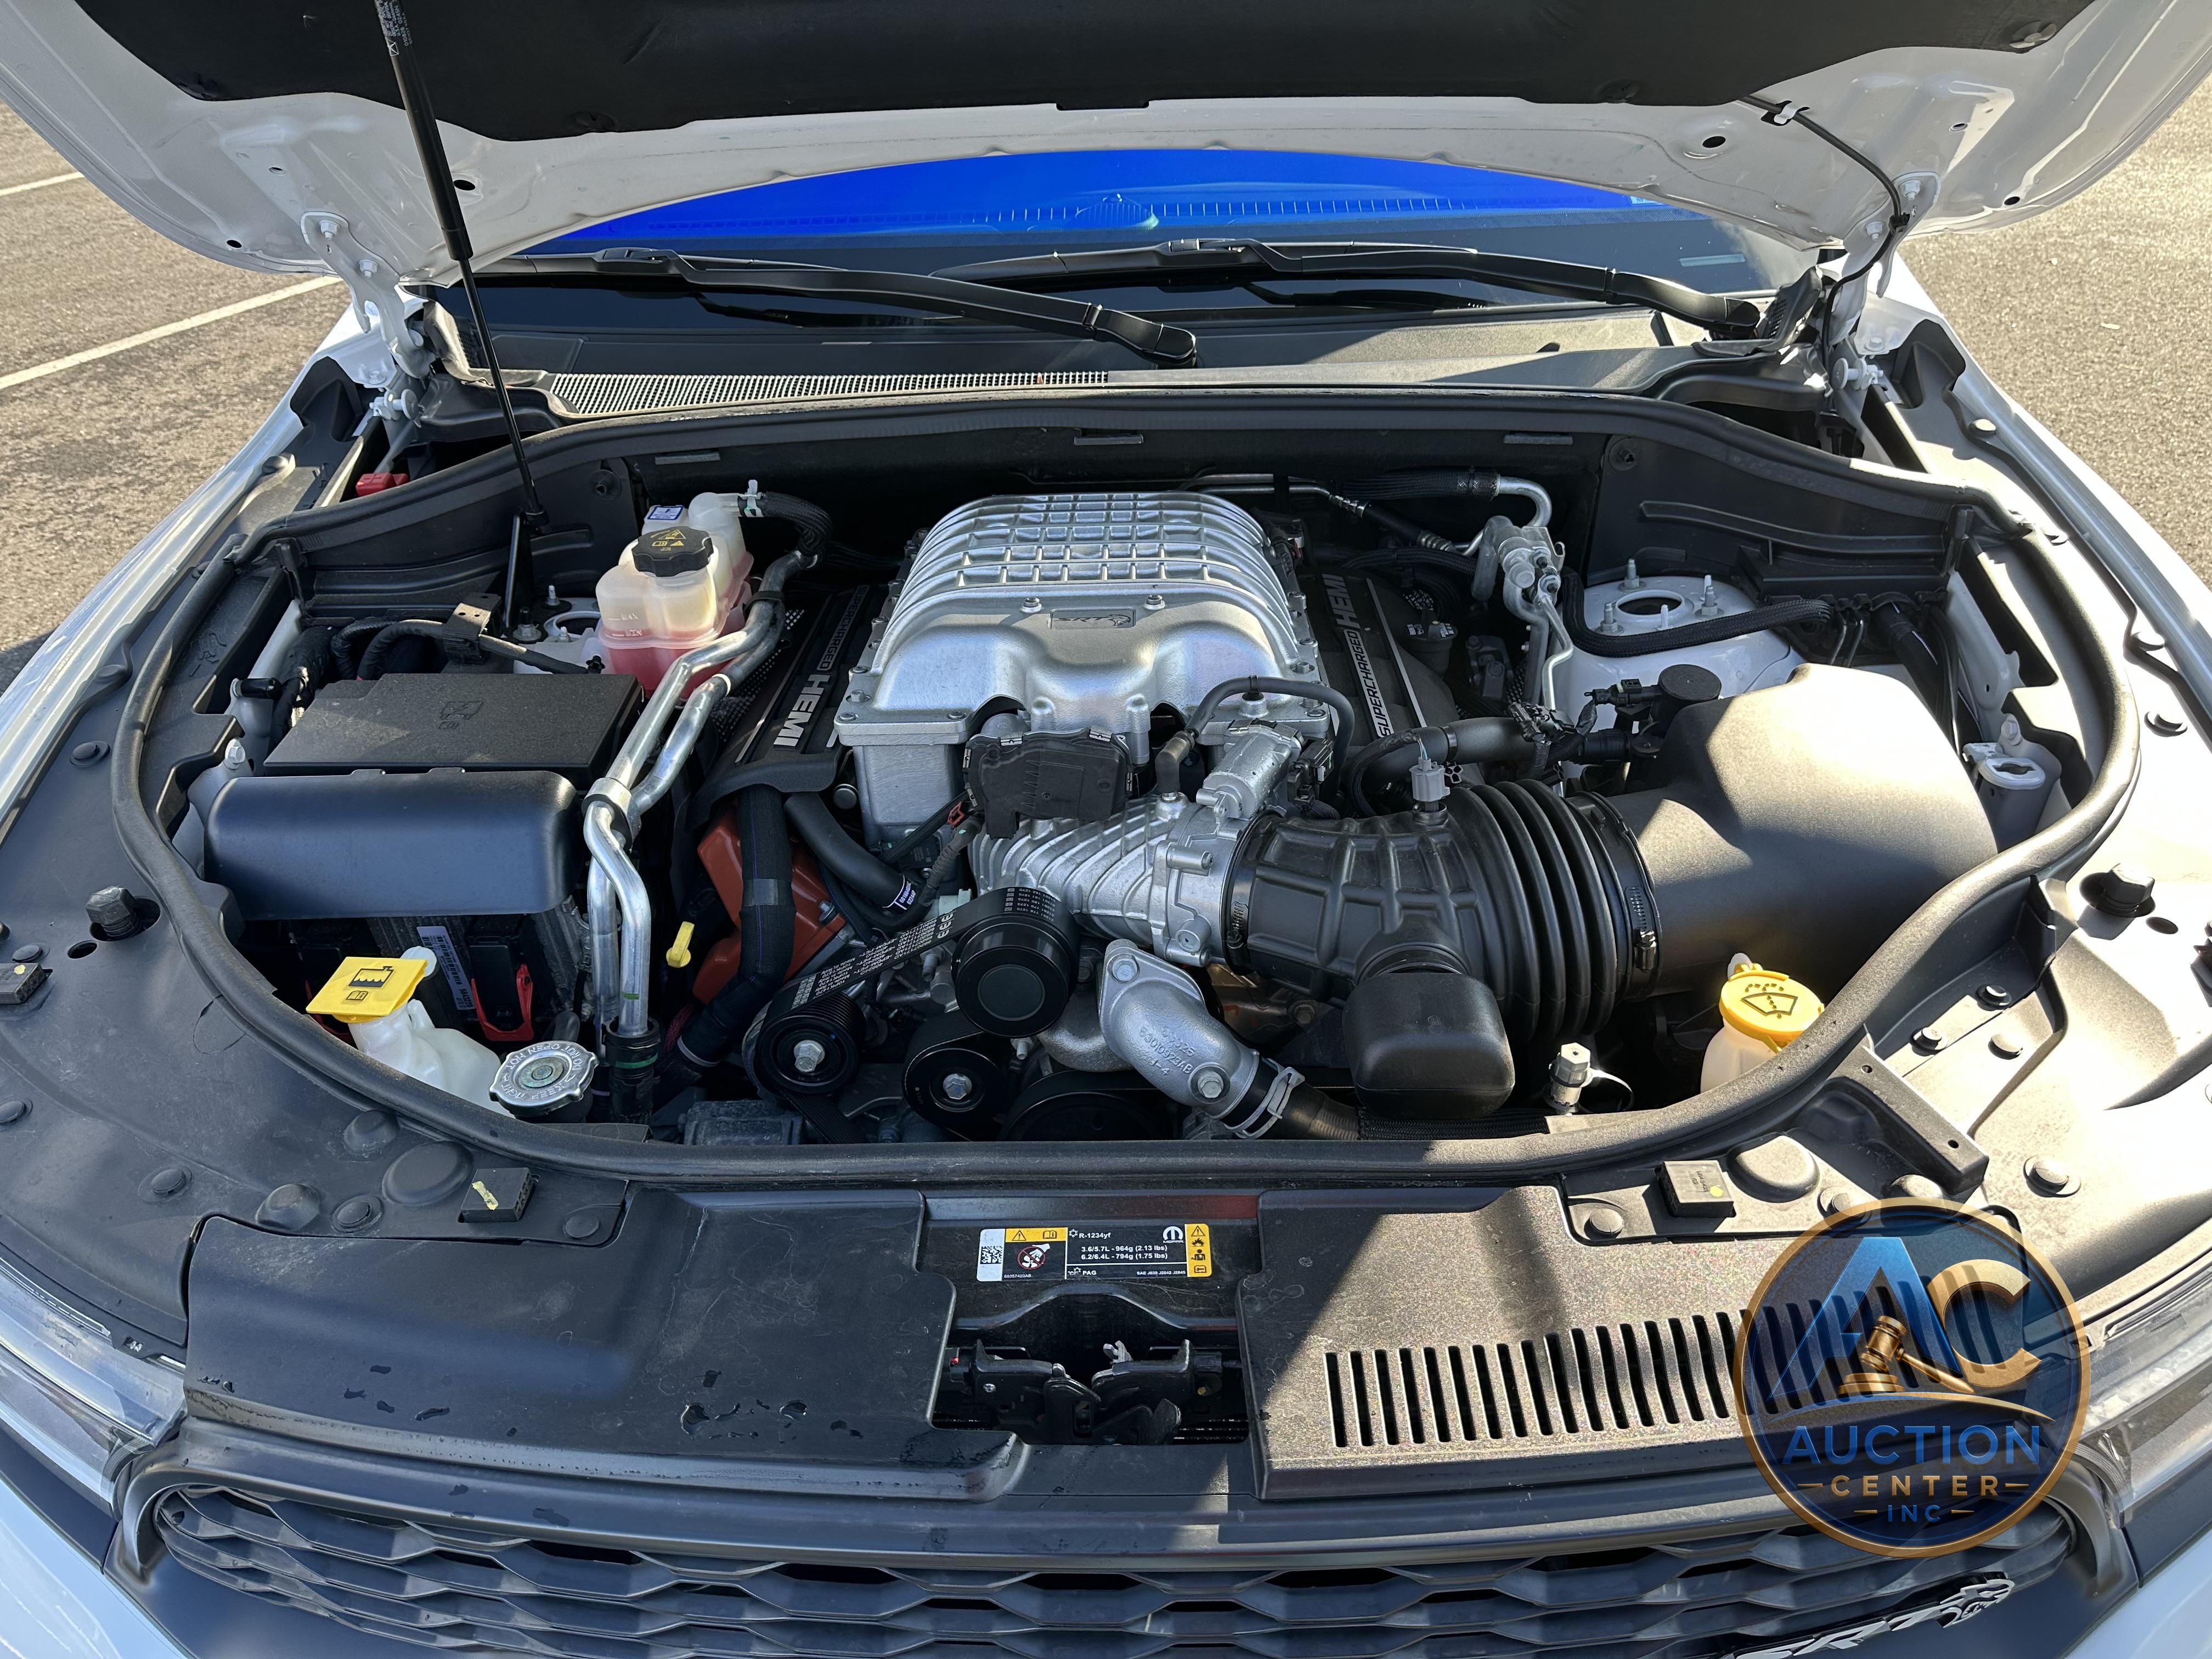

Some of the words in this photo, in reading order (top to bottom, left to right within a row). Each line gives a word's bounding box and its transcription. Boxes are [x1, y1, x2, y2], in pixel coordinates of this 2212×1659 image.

[1322, 573, 1361, 630] HEMI
[818, 585, 869, 669] SUPERCHARGED
[1347, 631, 1393, 736] SUPERCHARGED
[774, 674, 831, 747] HEMI
[505, 1052, 527, 1070] HOT
[528, 1043, 560, 1055] OPEN
[561, 1045, 580, 1058] NOT
[572, 1058, 583, 1070] DO
